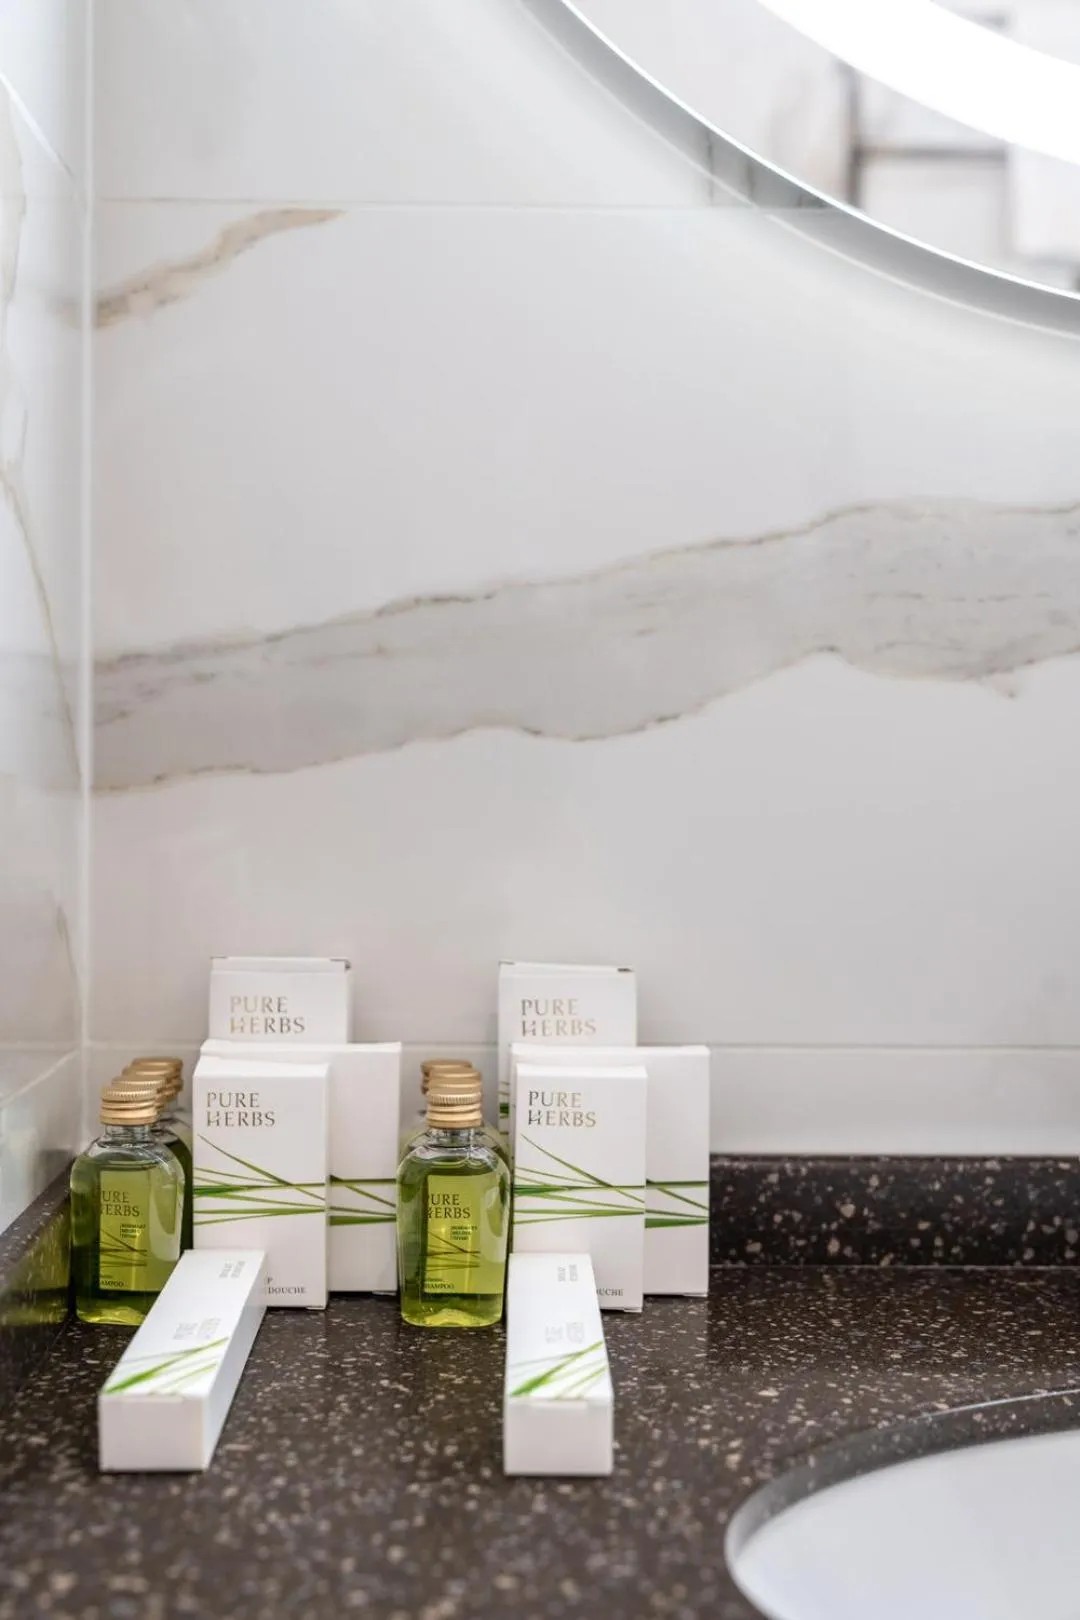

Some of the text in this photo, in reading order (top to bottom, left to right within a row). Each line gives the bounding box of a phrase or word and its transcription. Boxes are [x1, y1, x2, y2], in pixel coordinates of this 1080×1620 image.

[230, 996, 289, 1013] PURE
[521, 998, 579, 1016] PURE
[229, 1017, 305, 1035] HERBS
[522, 1019, 597, 1037] HERBS
[207, 1091, 260, 1108] PURE
[529, 1090, 582, 1108] PURE
[206, 1111, 275, 1127] HERBS
[528, 1110, 597, 1127] HERBS
[101, 1190, 130, 1203] URE
[428, 1193, 460, 1206] URE
[101, 1203, 140, 1217] ERBS
[268, 1286, 307, 1295] DOUCHE
